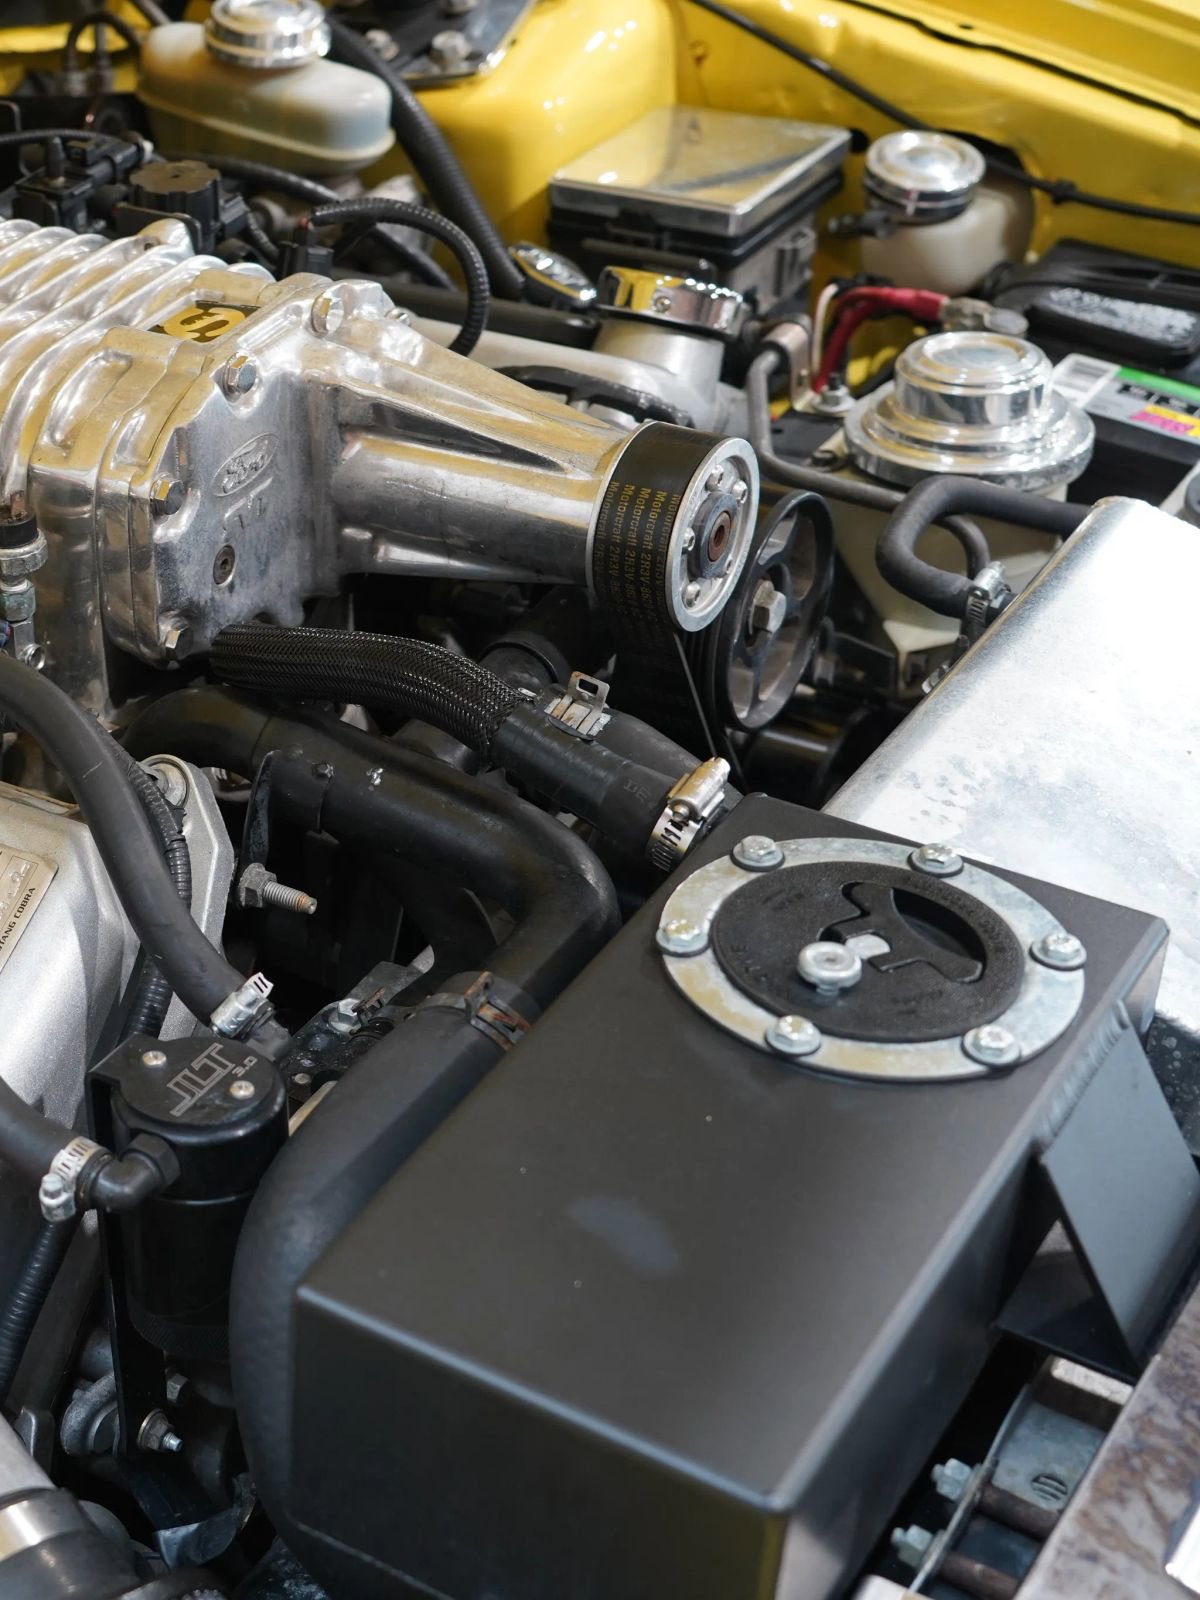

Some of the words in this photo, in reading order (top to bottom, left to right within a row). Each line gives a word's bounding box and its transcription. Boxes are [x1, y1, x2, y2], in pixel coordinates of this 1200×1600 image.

[597, 481, 620, 540] Motorcraft
[611, 484, 636, 543] Motorcraft
[627, 487, 652, 546] Motorcraft
[642, 490, 668, 550] Motorcraft
[657, 494, 681, 552] Motorcraft
[13, 887, 37, 918] COBRA
[166, 1042, 236, 1117] JLT
